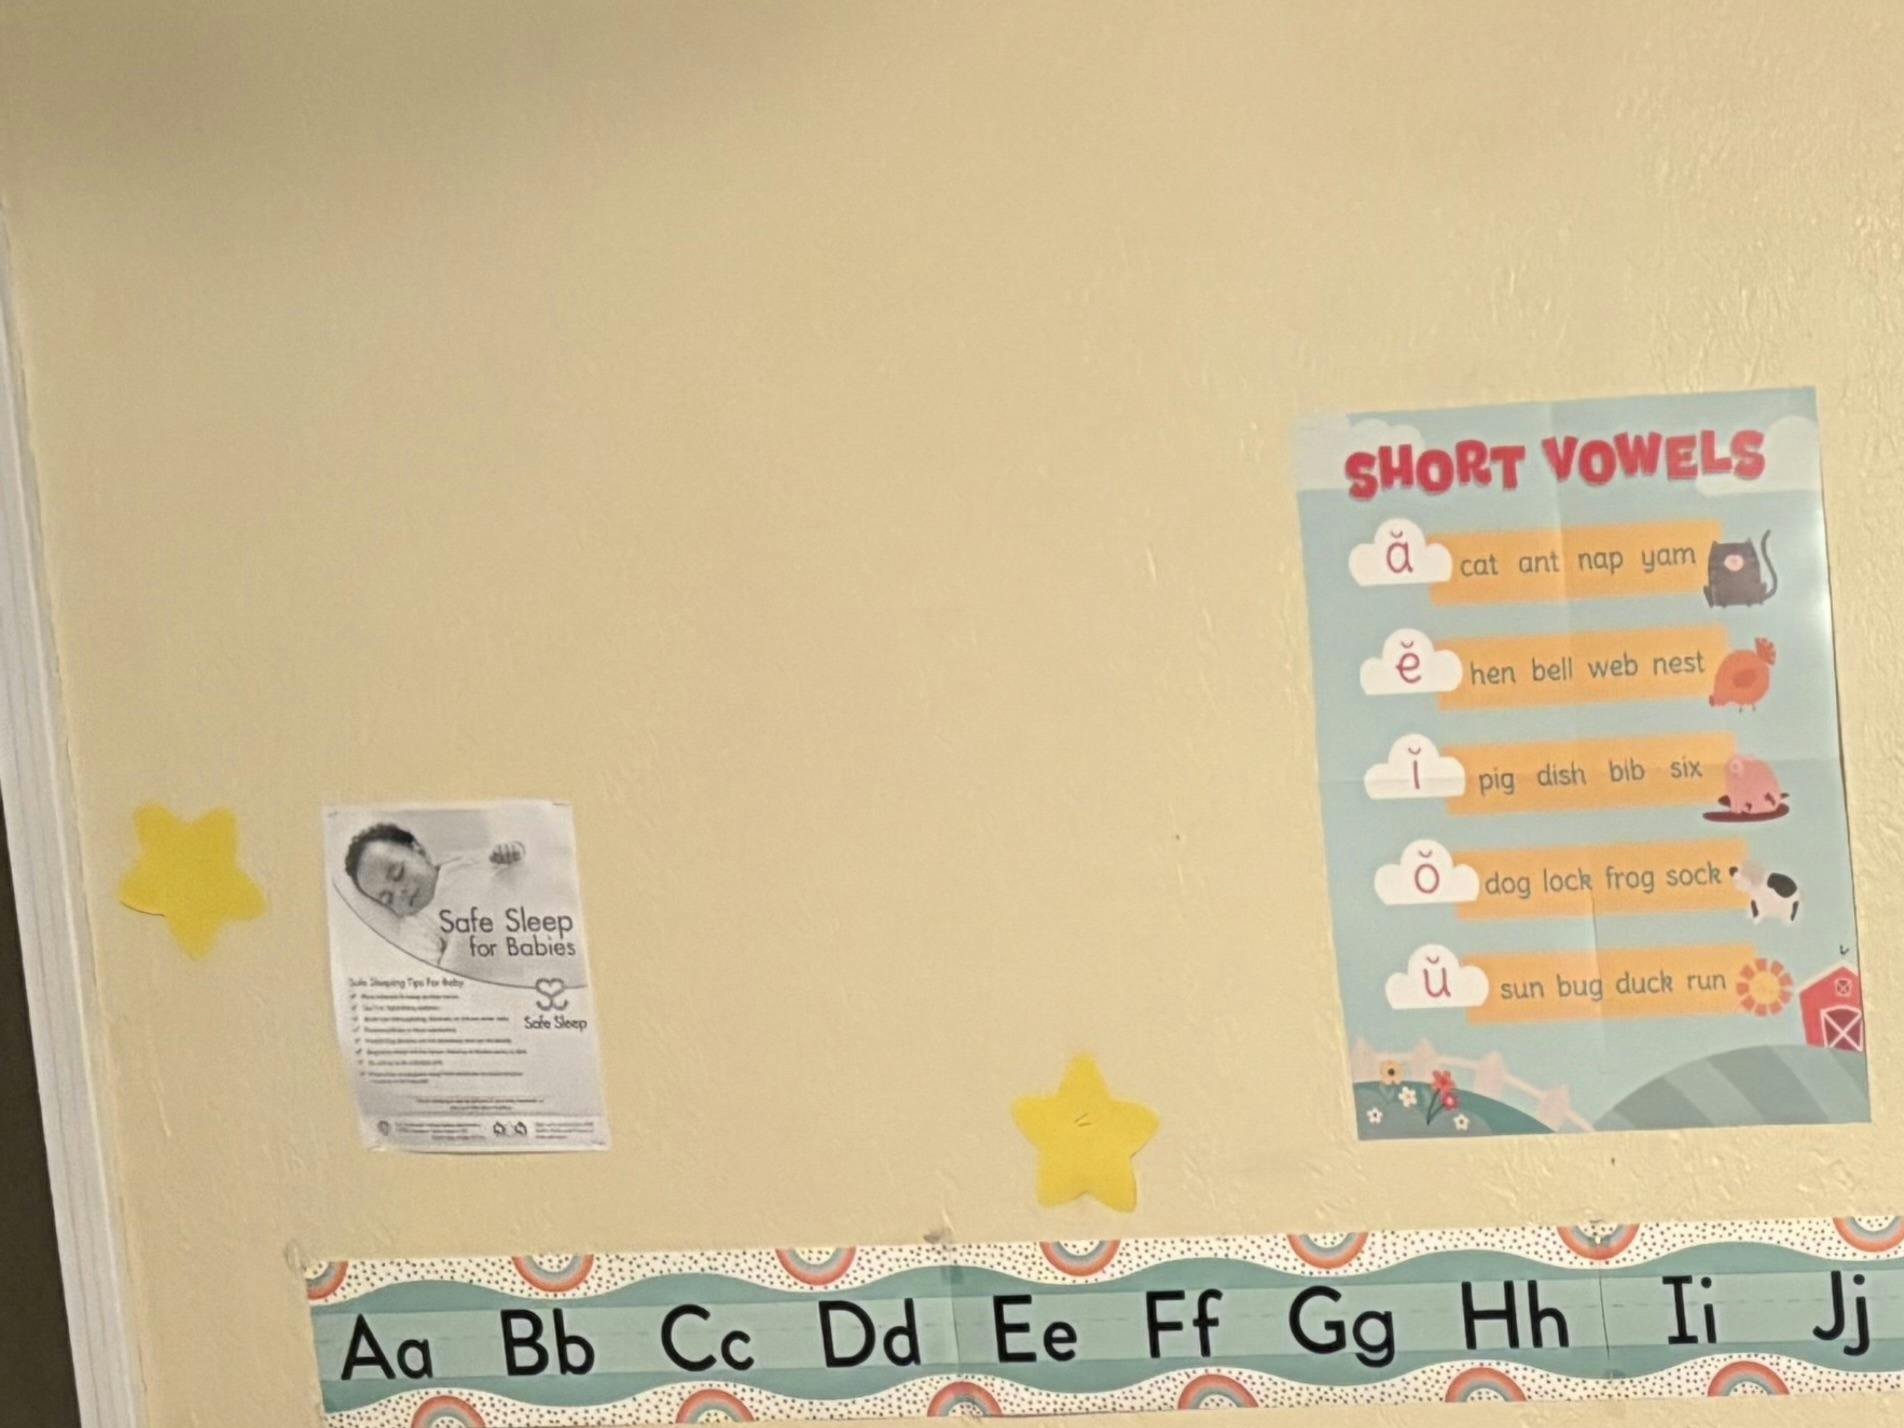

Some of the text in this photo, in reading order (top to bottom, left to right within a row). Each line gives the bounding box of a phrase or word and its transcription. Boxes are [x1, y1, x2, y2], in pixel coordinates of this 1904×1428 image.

[1345, 431, 1764, 501] SHORT VOWELS
[1460, 554, 1498, 577] cat
[1519, 552, 1559, 573] ant
[1578, 551, 1623, 575] nap
[1642, 547, 1696, 574] yam
[1470, 661, 1516, 685] hen
[1532, 657, 1572, 681] bell
[1588, 651, 1638, 678] web
[1653, 650, 1704, 675] nest
[1479, 768, 1515, 796] pig
[1536, 761, 1586, 786] dish
[1609, 758, 1645, 782] bib
[1670, 761, 1703, 778] six
[1485, 872, 1531, 899] dog
[1544, 867, 1592, 892] lock
[1606, 865, 1654, 894] frog
[1666, 861, 1722, 886] sock
[439, 906, 573, 940] Safe Sleep
[470, 935, 575, 957] for Babies
[370, 978, 406, 990] Sleeping
[407, 978, 424, 990] Tips
[426, 978, 439, 988] For
[1501, 981, 1544, 1000] sun
[1556, 974, 1603, 1002] bug
[1616, 969, 1673, 994] duck
[1686, 966, 1727, 992] run
[524, 1015, 587, 1032] Safe Sleep
[341, 1314, 433, 1380] Aa
[501, 1308, 594, 1376] Bb
[661, 1304, 754, 1372] Cc
[819, 1298, 920, 1368] Dd
[993, 1294, 1077, 1363] Ee
[1146, 1289, 1222, 1358] Ff
[1289, 1286, 1395, 1368] Gg
[1462, 1280, 1569, 1350] Hh
[1662, 1275, 1716, 1345] Ii
[1813, 1271, 1869, 1356] Jj
